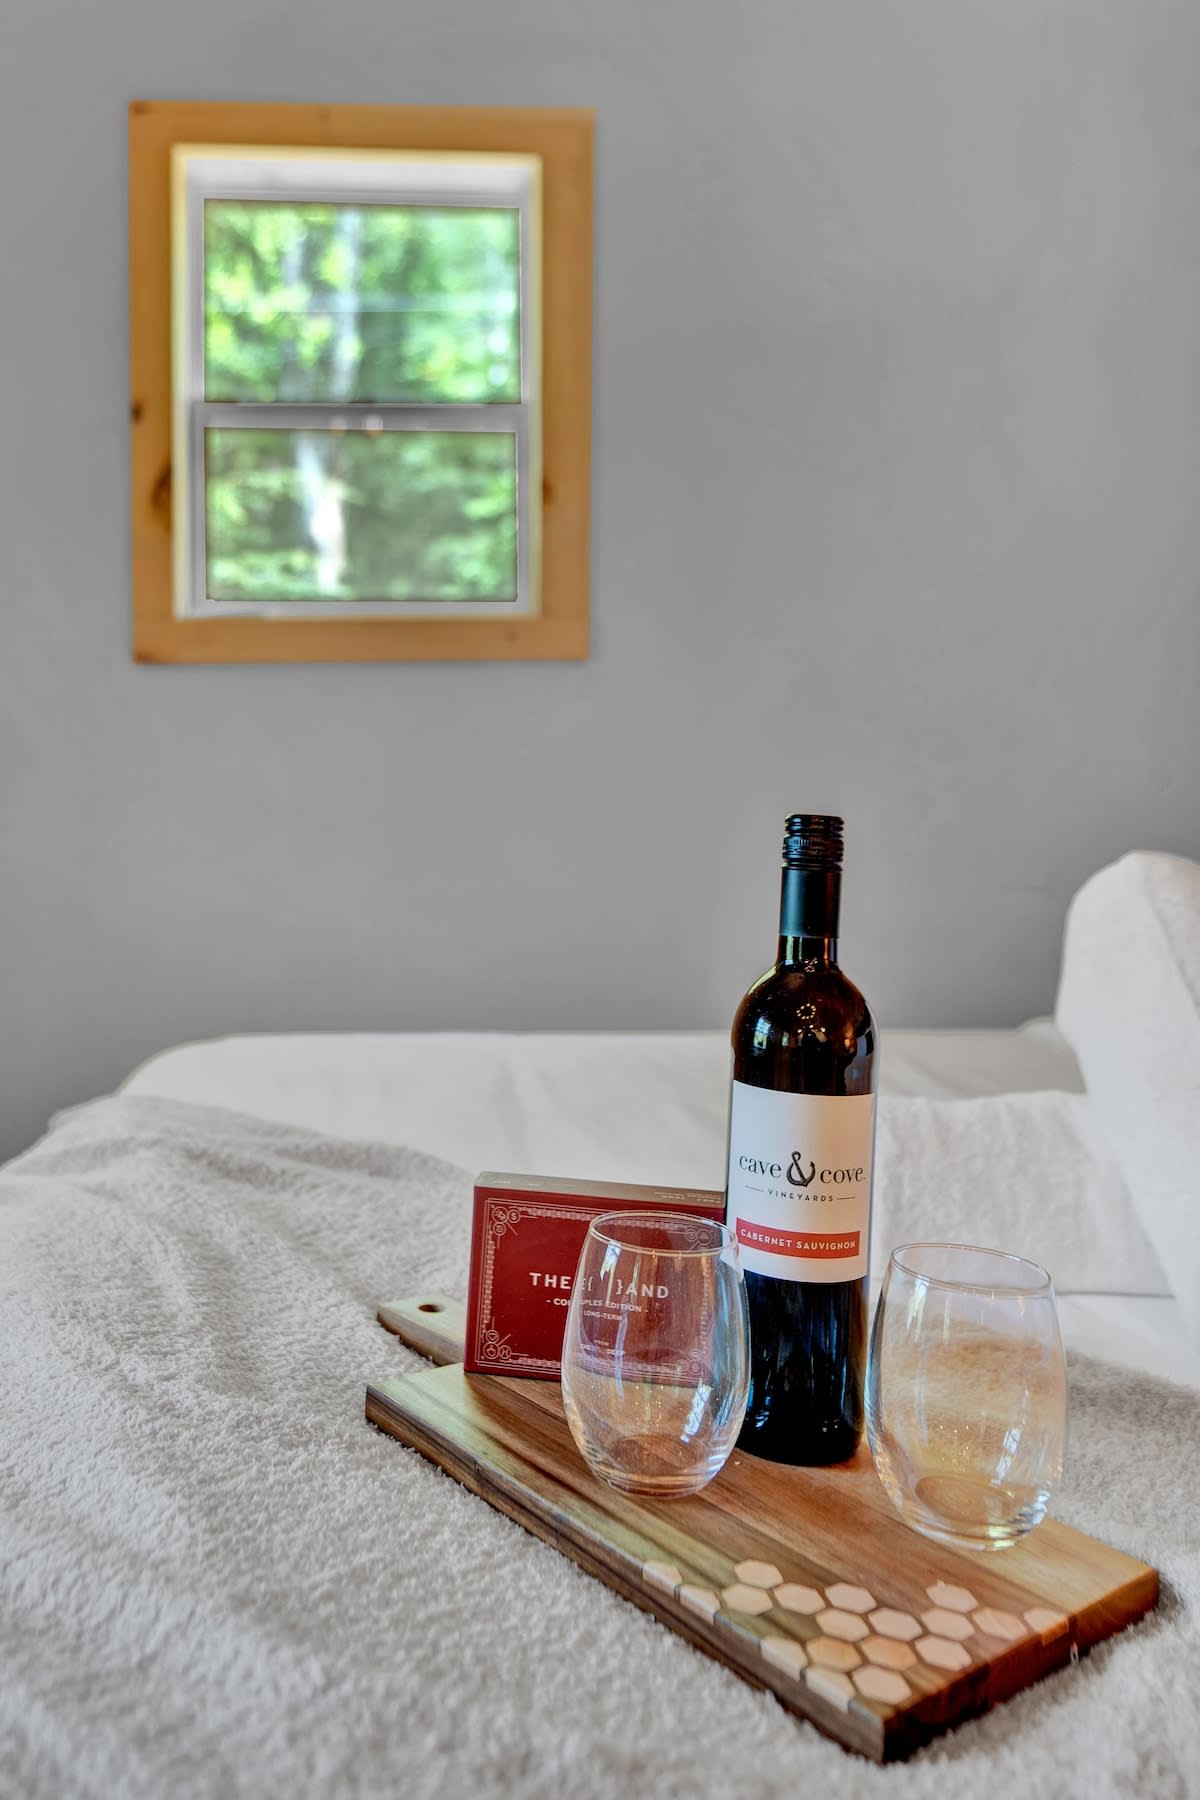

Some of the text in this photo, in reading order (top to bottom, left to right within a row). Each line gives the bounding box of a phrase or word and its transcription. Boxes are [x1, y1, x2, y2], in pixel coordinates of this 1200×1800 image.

[738, 1154, 782, 1179] cave
[786, 1150, 816, 1188] &
[768, 1189, 834, 1202] VINEYARDS
[740, 1228, 856, 1251] CABERNET SAUVIGNON
[529, 1272, 572, 1290] THE
[625, 1282, 669, 1299] AND
[583, 1310, 624, 1321] LONG-TERM
[605, 1301, 642, 1313] EDITION
